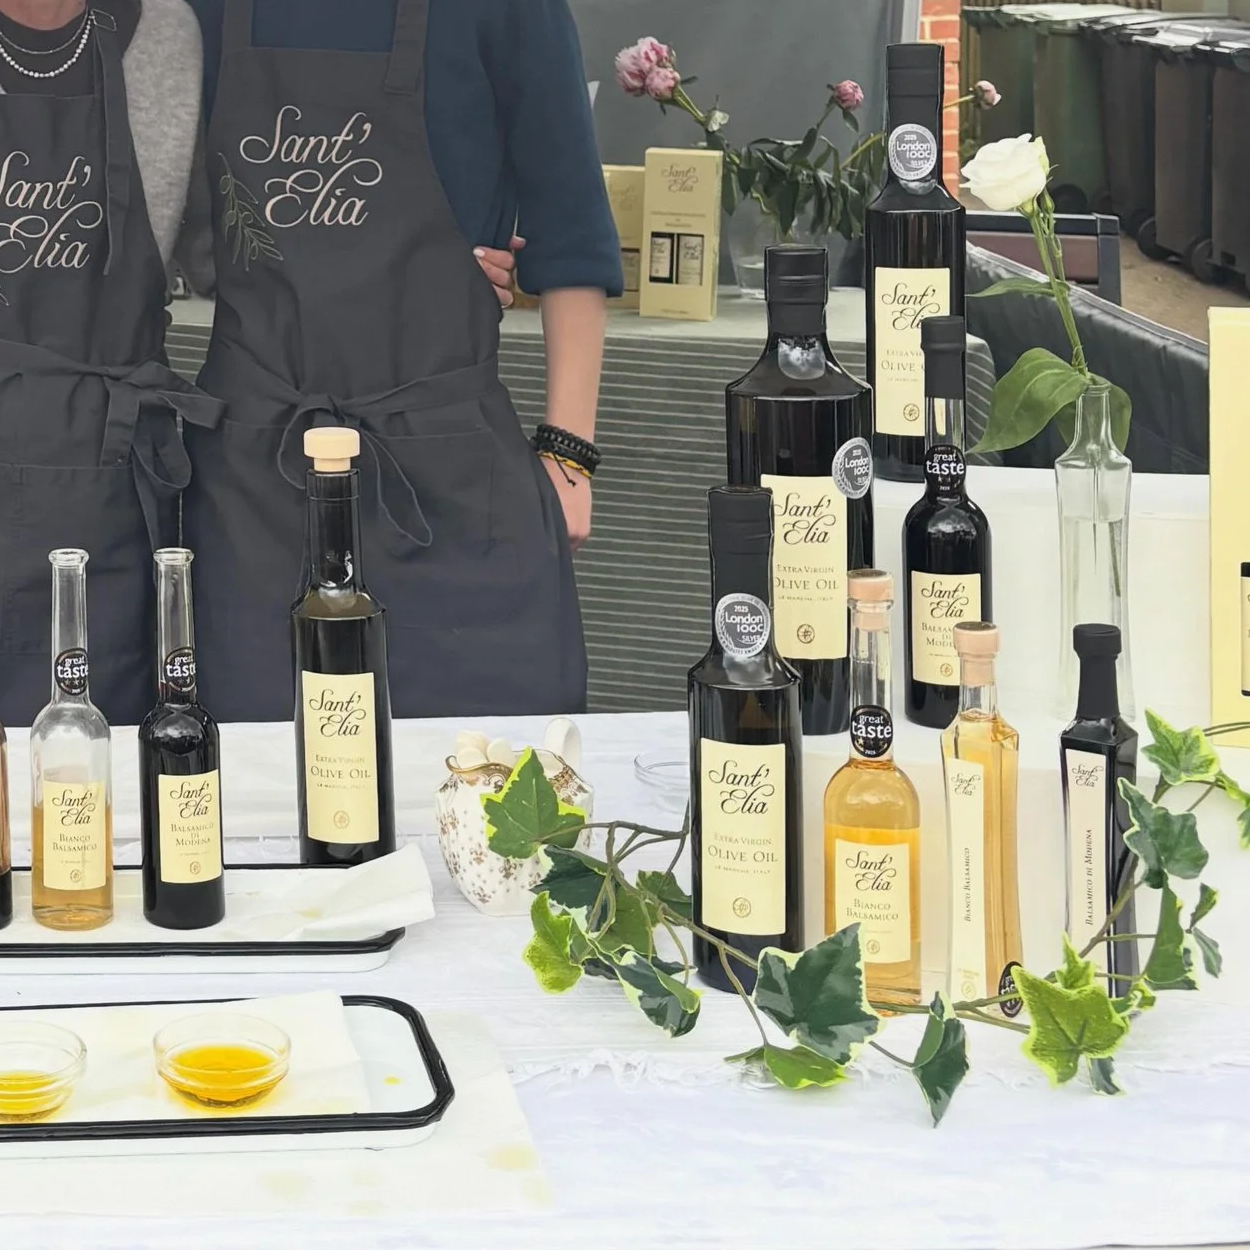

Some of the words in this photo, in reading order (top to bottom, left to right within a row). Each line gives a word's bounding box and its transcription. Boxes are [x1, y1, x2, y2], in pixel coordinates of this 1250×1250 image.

[240, 105, 371, 164] Sant'
[896, 141, 930, 150] London
[263, 157, 383, 227] Elia
[881, 282, 936, 306] Sant'
[891, 302, 941, 331] Eli
[933, 452, 956, 462] great
[926, 460, 964, 476] taste
[782, 514, 836, 545] Elia
[816, 578, 839, 590] OIL
[921, 580, 965, 598] Sant'
[930, 596, 969, 618] Elia
[726, 612, 763, 624] London
[64, 656, 86, 668] great
[309, 688, 362, 712] Sant'
[319, 708, 366, 738] Elia
[859, 715, 884, 724] great
[852, 720, 892, 738] taste
[310, 766, 344, 778] OLIVE
[350, 768, 370, 779] OIL
[708, 760, 770, 787] Sant'
[170, 781, 210, 800] Sant'
[719, 784, 775, 814] Elia
[60, 805, 96, 827] Elia
[178, 796, 212, 819] Elia
[170, 823, 214, 833] BALSAMICO
[52, 842, 97, 852] BALSAMICO
[59, 834, 91, 843] BIANCO
[176, 838, 211, 846] MODENA
[714, 832, 739, 844] EXTRA
[708, 844, 748, 862] OLIVE
[753, 850, 778, 862] OIL
[1084, 829, 1092, 866] MODENA
[846, 850, 892, 870] Sant'
[854, 868, 897, 891] Elia
[854, 898, 890, 910] BIANCO
[846, 907, 898, 920] BALSAMICO
